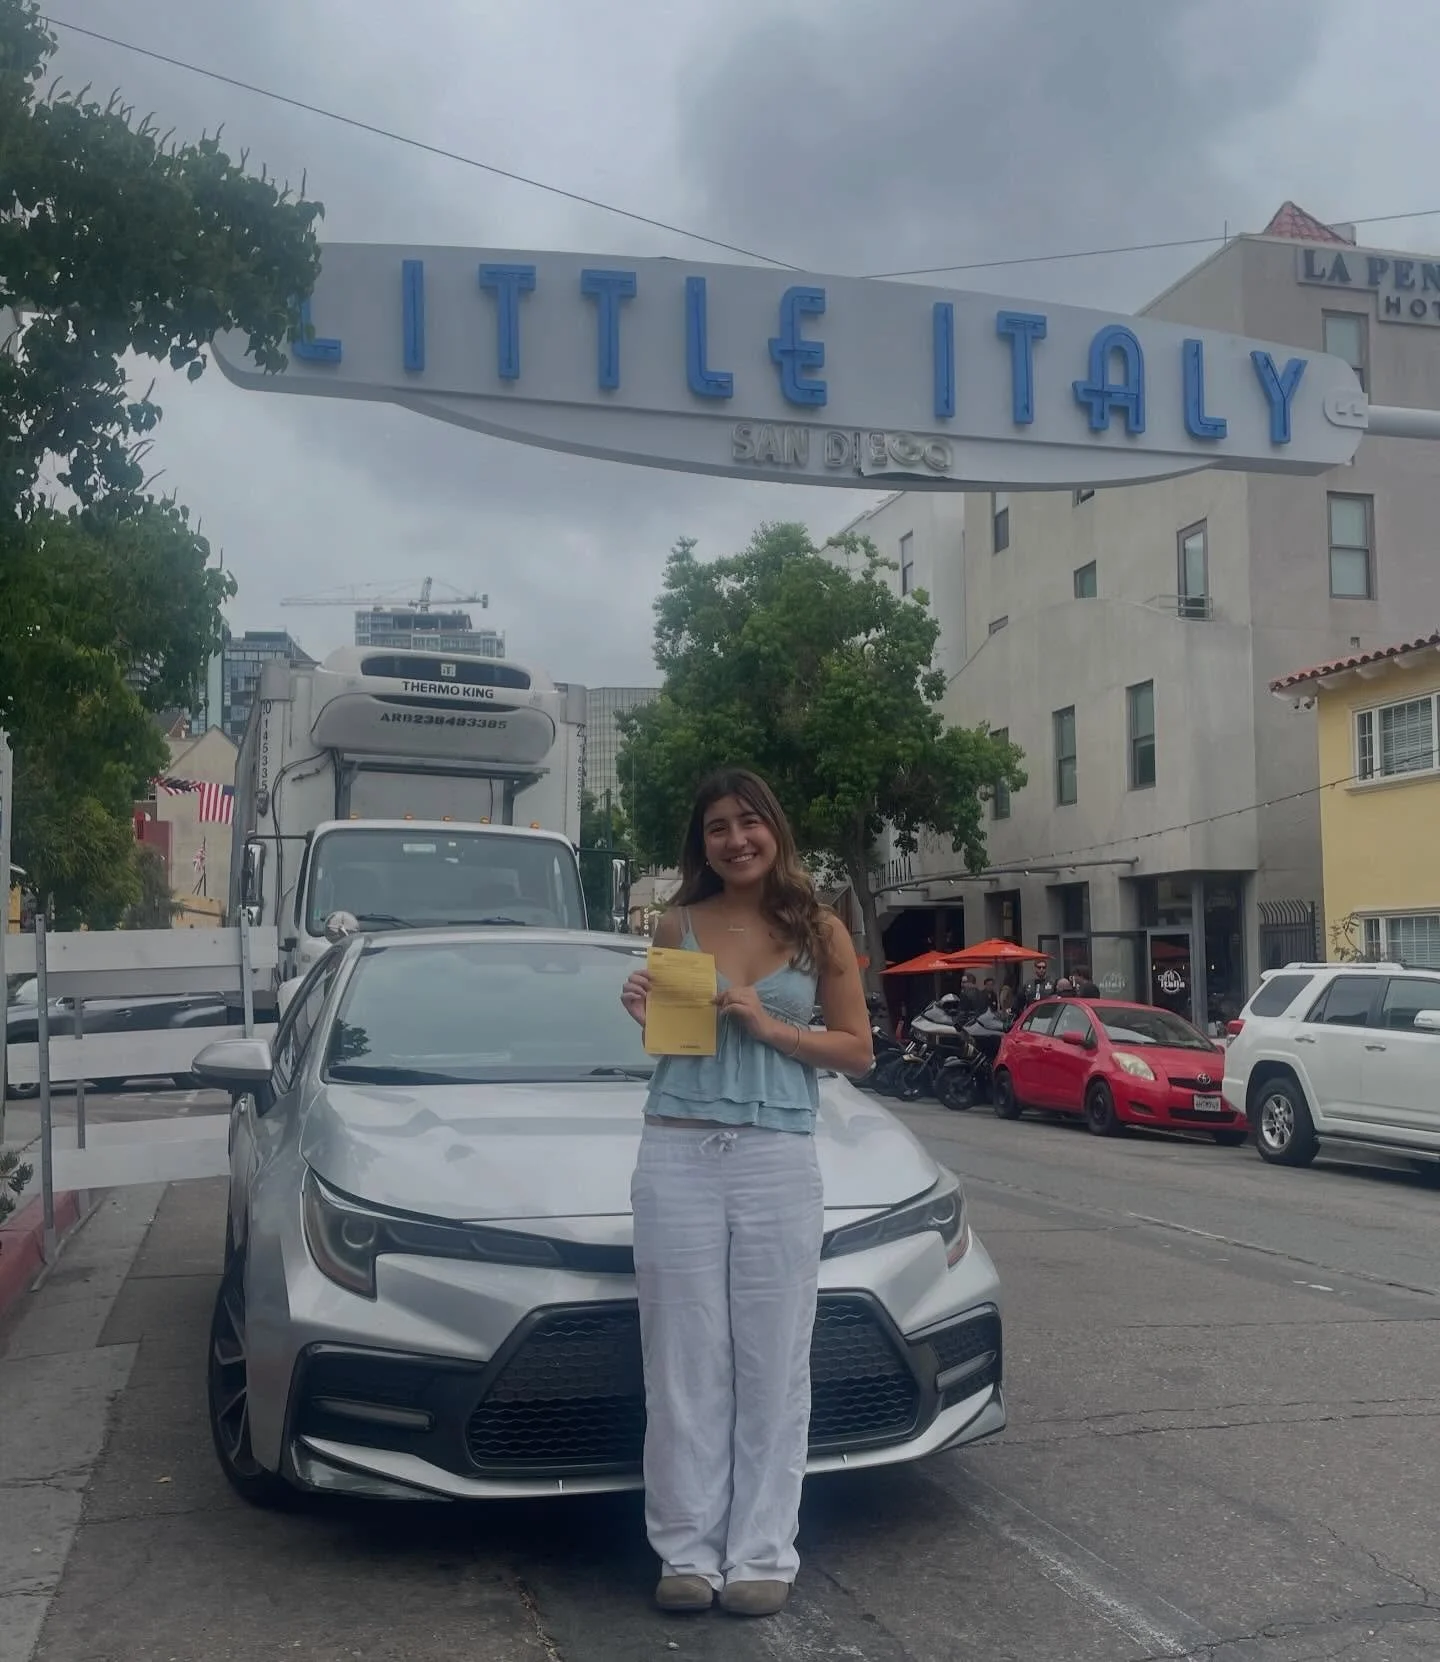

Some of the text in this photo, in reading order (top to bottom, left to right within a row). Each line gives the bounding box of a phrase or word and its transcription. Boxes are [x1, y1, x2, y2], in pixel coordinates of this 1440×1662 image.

[1303, 249, 1352, 283] LA
[291, 259, 1308, 444] LITTLE ITALY
[732, 422, 953, 472] SAN DIEGO
[401, 680, 494, 699] THERMO KING
